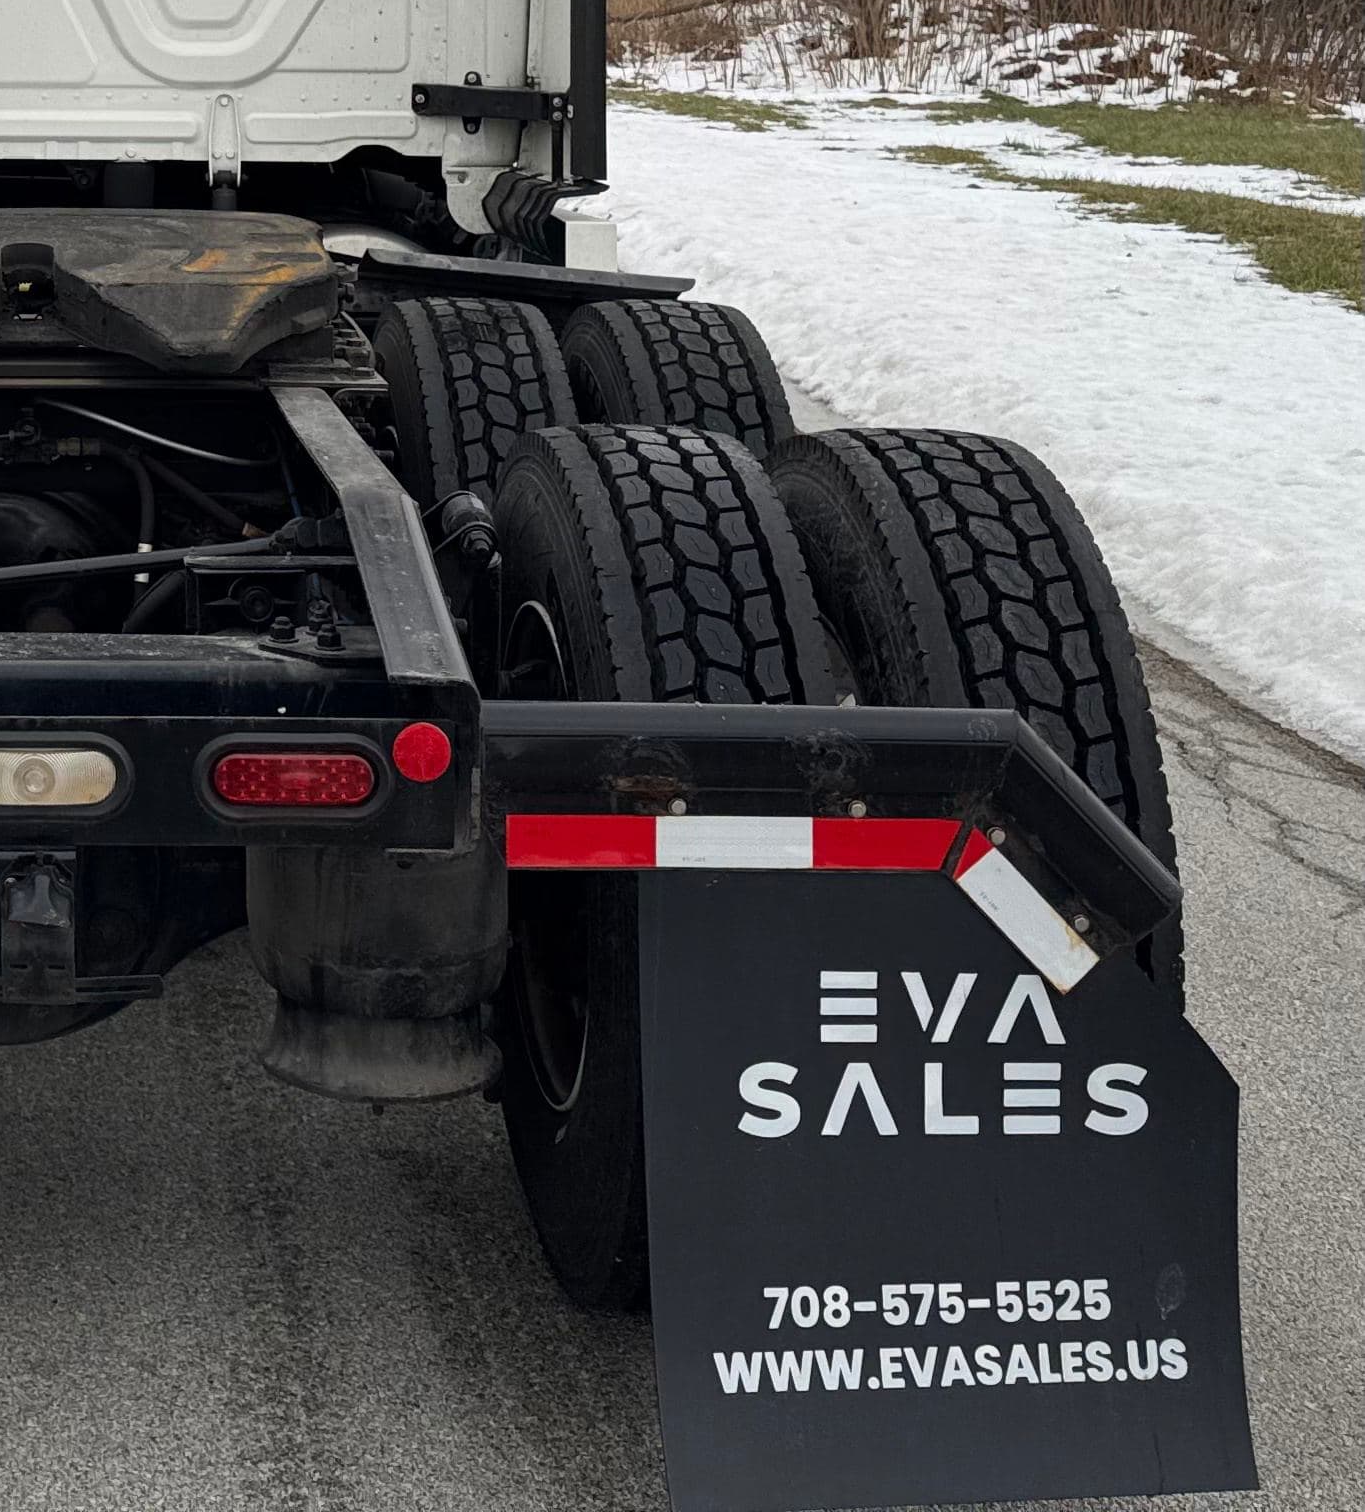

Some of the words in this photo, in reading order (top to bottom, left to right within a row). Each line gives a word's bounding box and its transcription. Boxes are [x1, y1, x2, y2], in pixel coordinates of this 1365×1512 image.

[819, 970, 1067, 1045] EVA
[737, 1061, 1149, 1138] SALES
[763, 1278, 1112, 1330] 708-575-5525
[712, 1339, 1189, 1394] WWW.EVASALES.US
